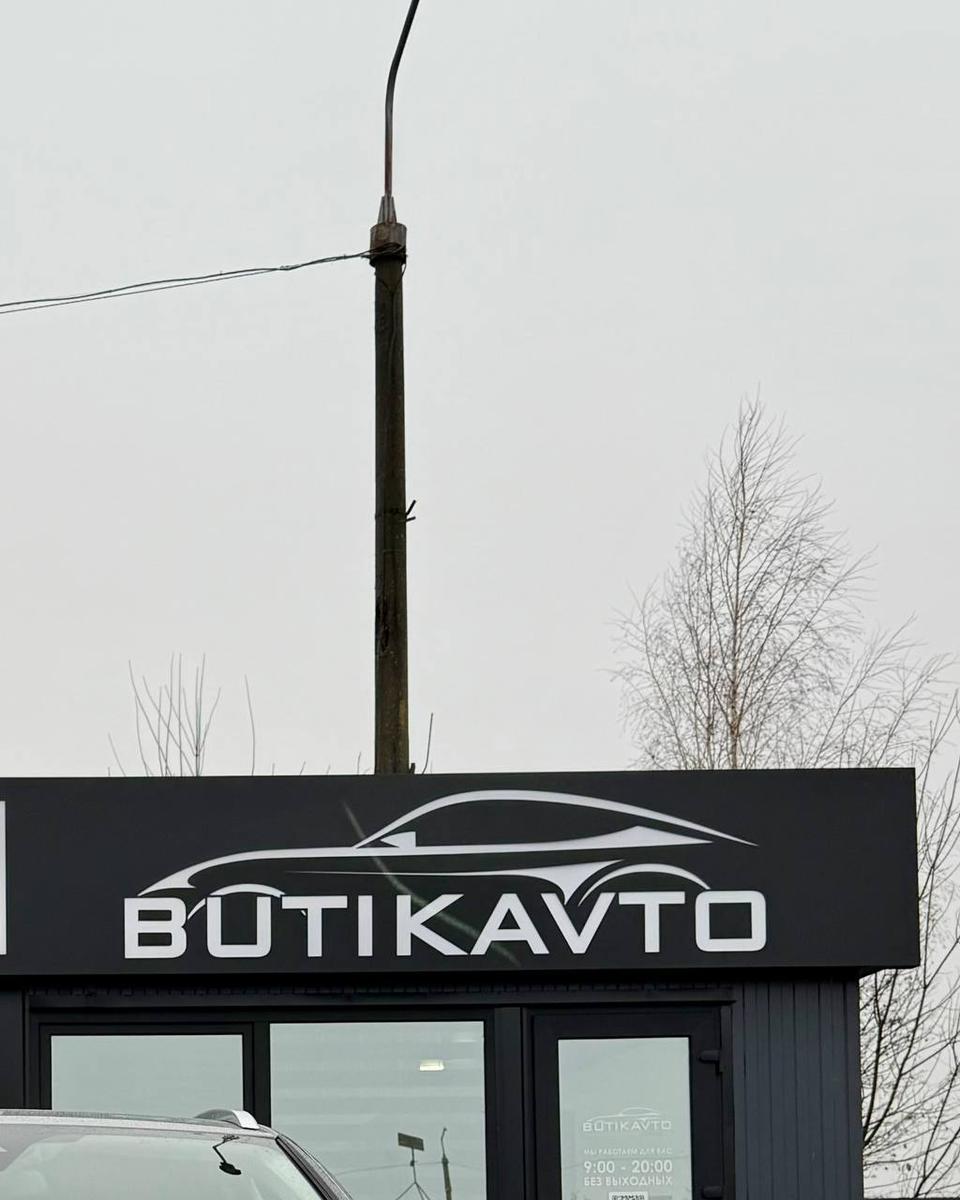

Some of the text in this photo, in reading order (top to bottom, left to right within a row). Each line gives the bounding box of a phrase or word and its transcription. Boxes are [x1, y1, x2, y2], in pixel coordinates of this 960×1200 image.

[123, 889, 768, 959] BUTIKAVTO
[583, 1120, 672, 1131] BUTIKAVTO
[584, 1160, 615, 1173] 9:00
[631, 1160, 673, 1173] 20:00
[584, 1176, 673, 1186] БЕЗ ВЫХОДНЫХ
